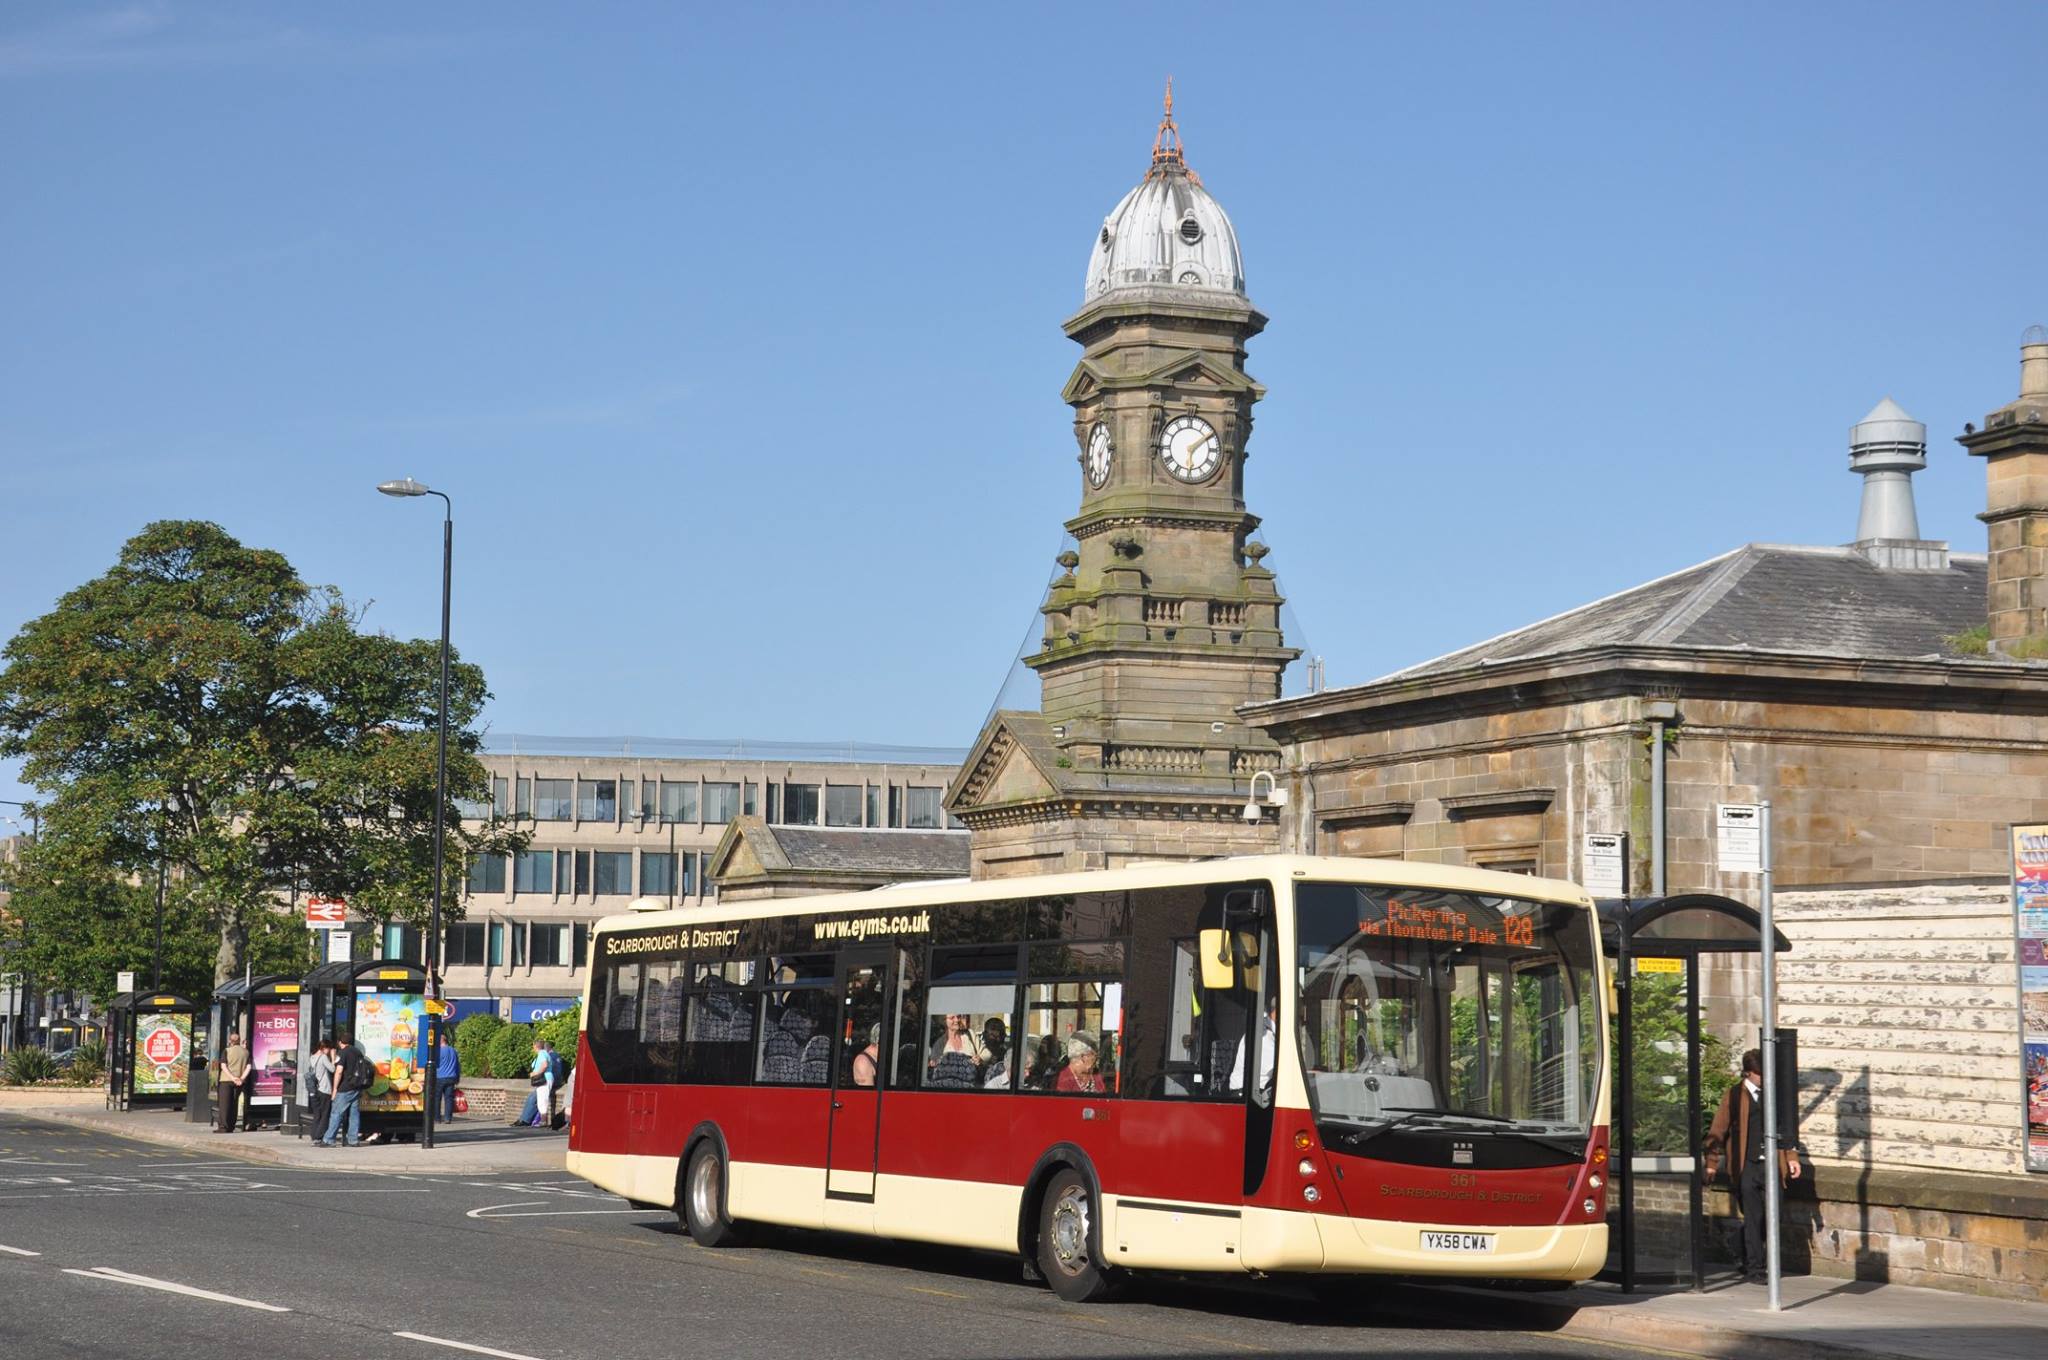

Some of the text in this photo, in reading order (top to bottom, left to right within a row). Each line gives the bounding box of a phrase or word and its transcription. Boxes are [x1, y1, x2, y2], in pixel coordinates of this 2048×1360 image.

[814, 910, 930, 942] www.eyms.co.uk
[1359, 919, 1380, 935] via
[1386, 919, 1448, 941] Thornton
[1469, 927, 1497, 945] Dale
[1504, 915, 1534, 946] 128
[606, 928, 740, 955] SCARBOROUGH & DISTRICT
[257, 1017, 296, 1029] THE BIG
[1450, 1174, 1477, 1187] 361
[1380, 1184, 1543, 1204] SCARBOROUGH & DISTRICT
[1427, 1234, 1487, 1250] YX58 CWA
